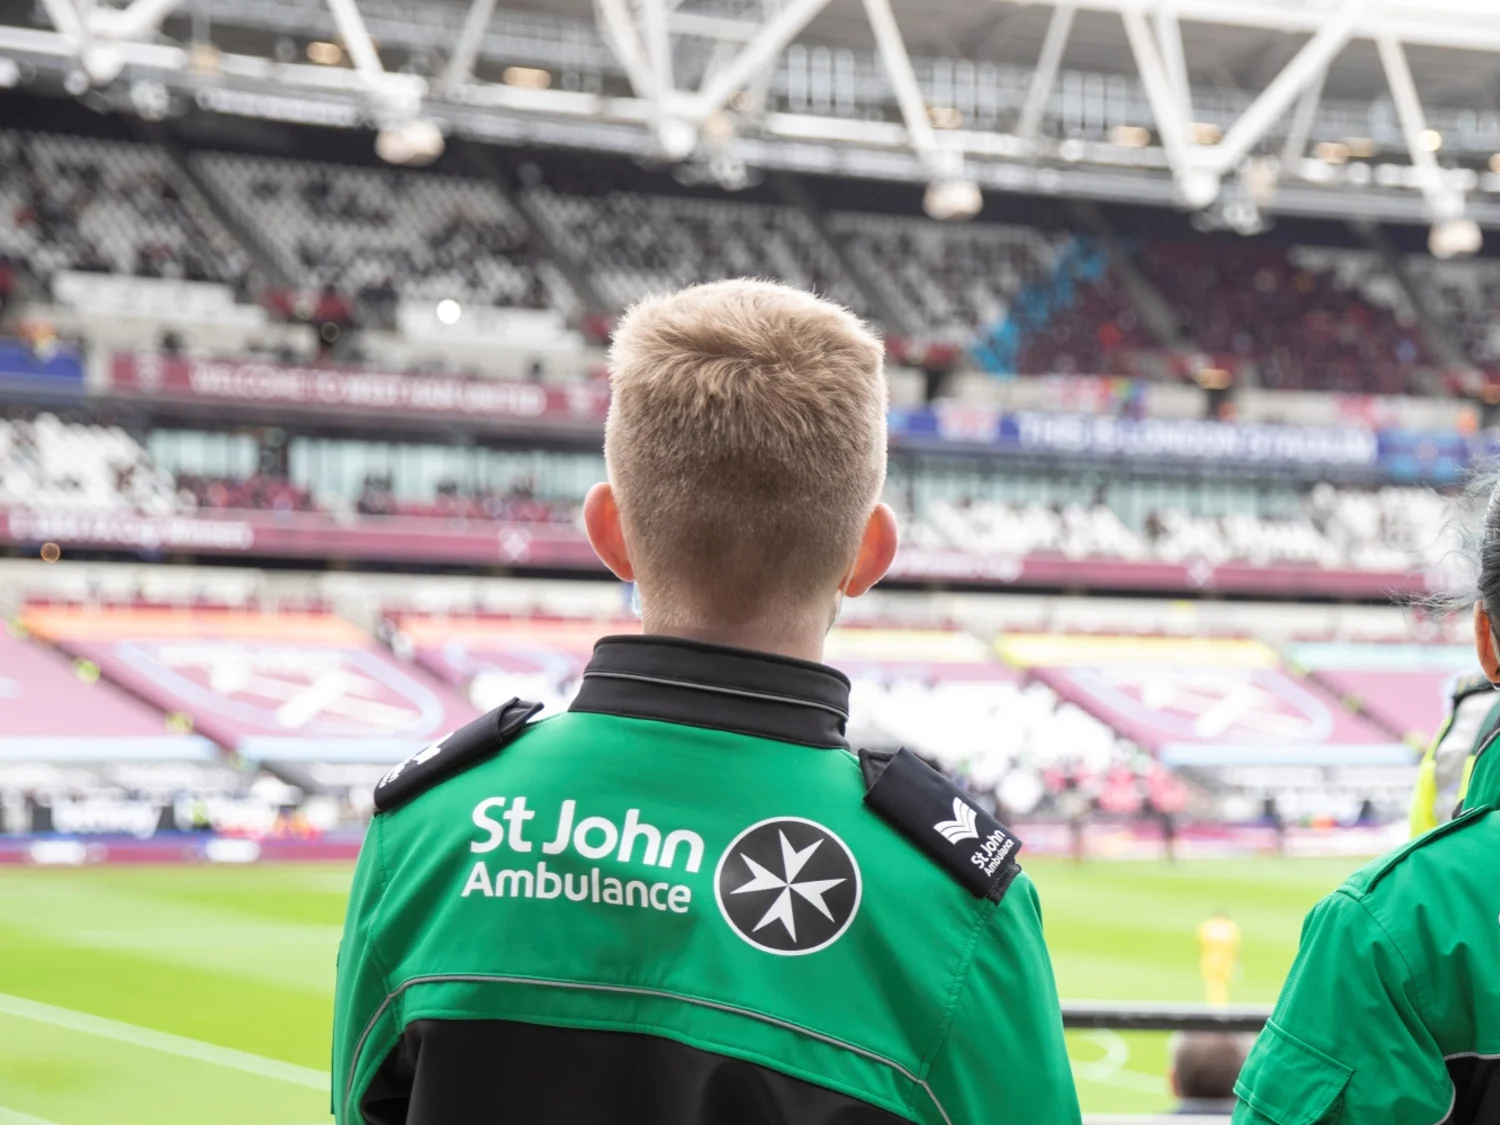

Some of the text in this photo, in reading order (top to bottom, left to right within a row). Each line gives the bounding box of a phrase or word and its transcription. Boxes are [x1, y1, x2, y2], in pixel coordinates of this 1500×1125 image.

[470, 796, 705, 873] St John
[971, 830, 1006, 870] St John
[983, 839, 1015, 878] Ambulance
[461, 861, 692, 914] Ambulance
